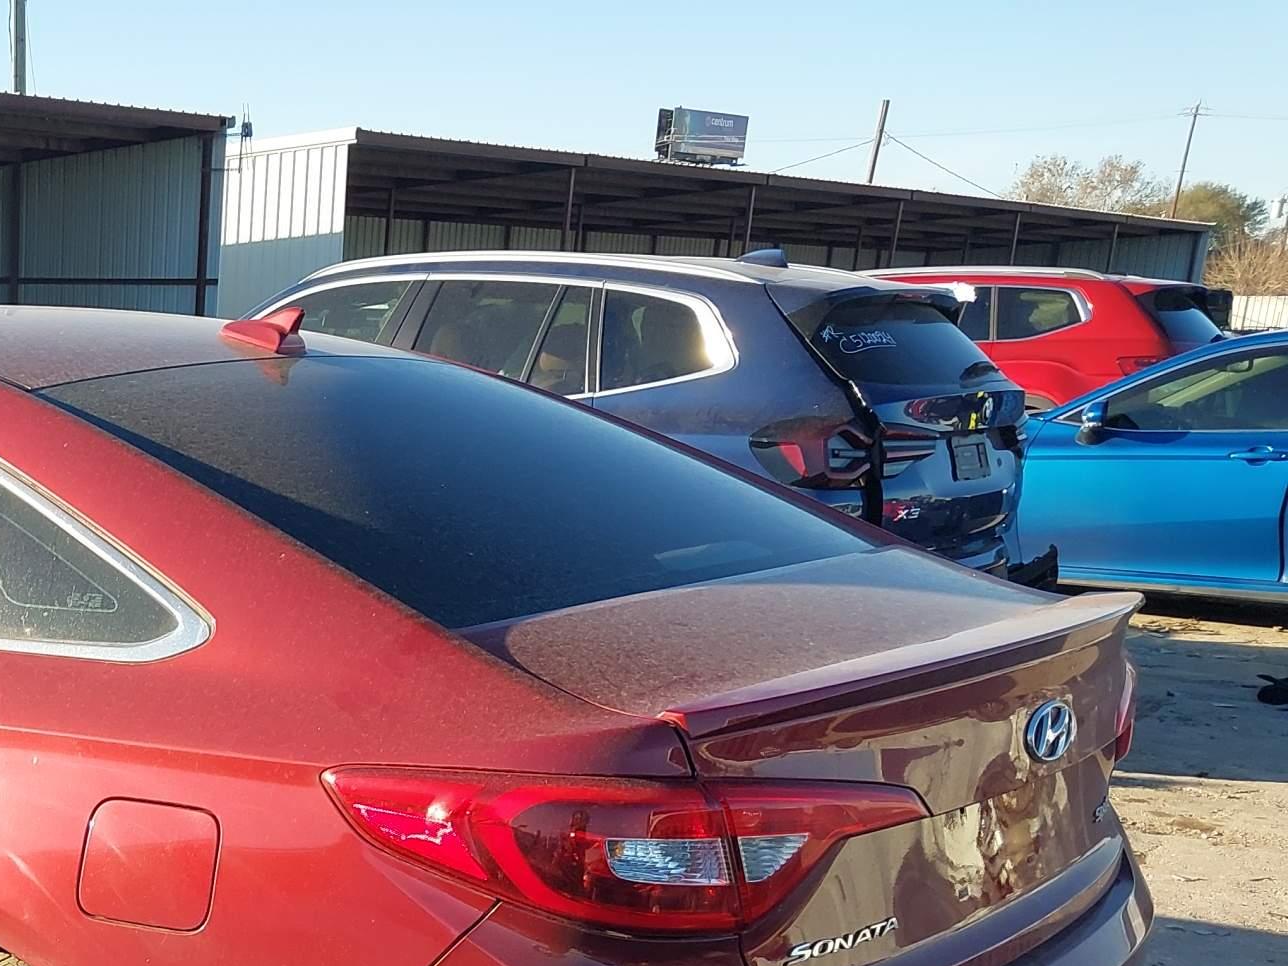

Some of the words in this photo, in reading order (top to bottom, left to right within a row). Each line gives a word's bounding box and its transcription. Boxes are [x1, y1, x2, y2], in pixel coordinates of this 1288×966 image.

[711, 116, 734, 128] centrum
[893, 505, 921, 521] X3
[783, 916, 900, 966] SONATA
